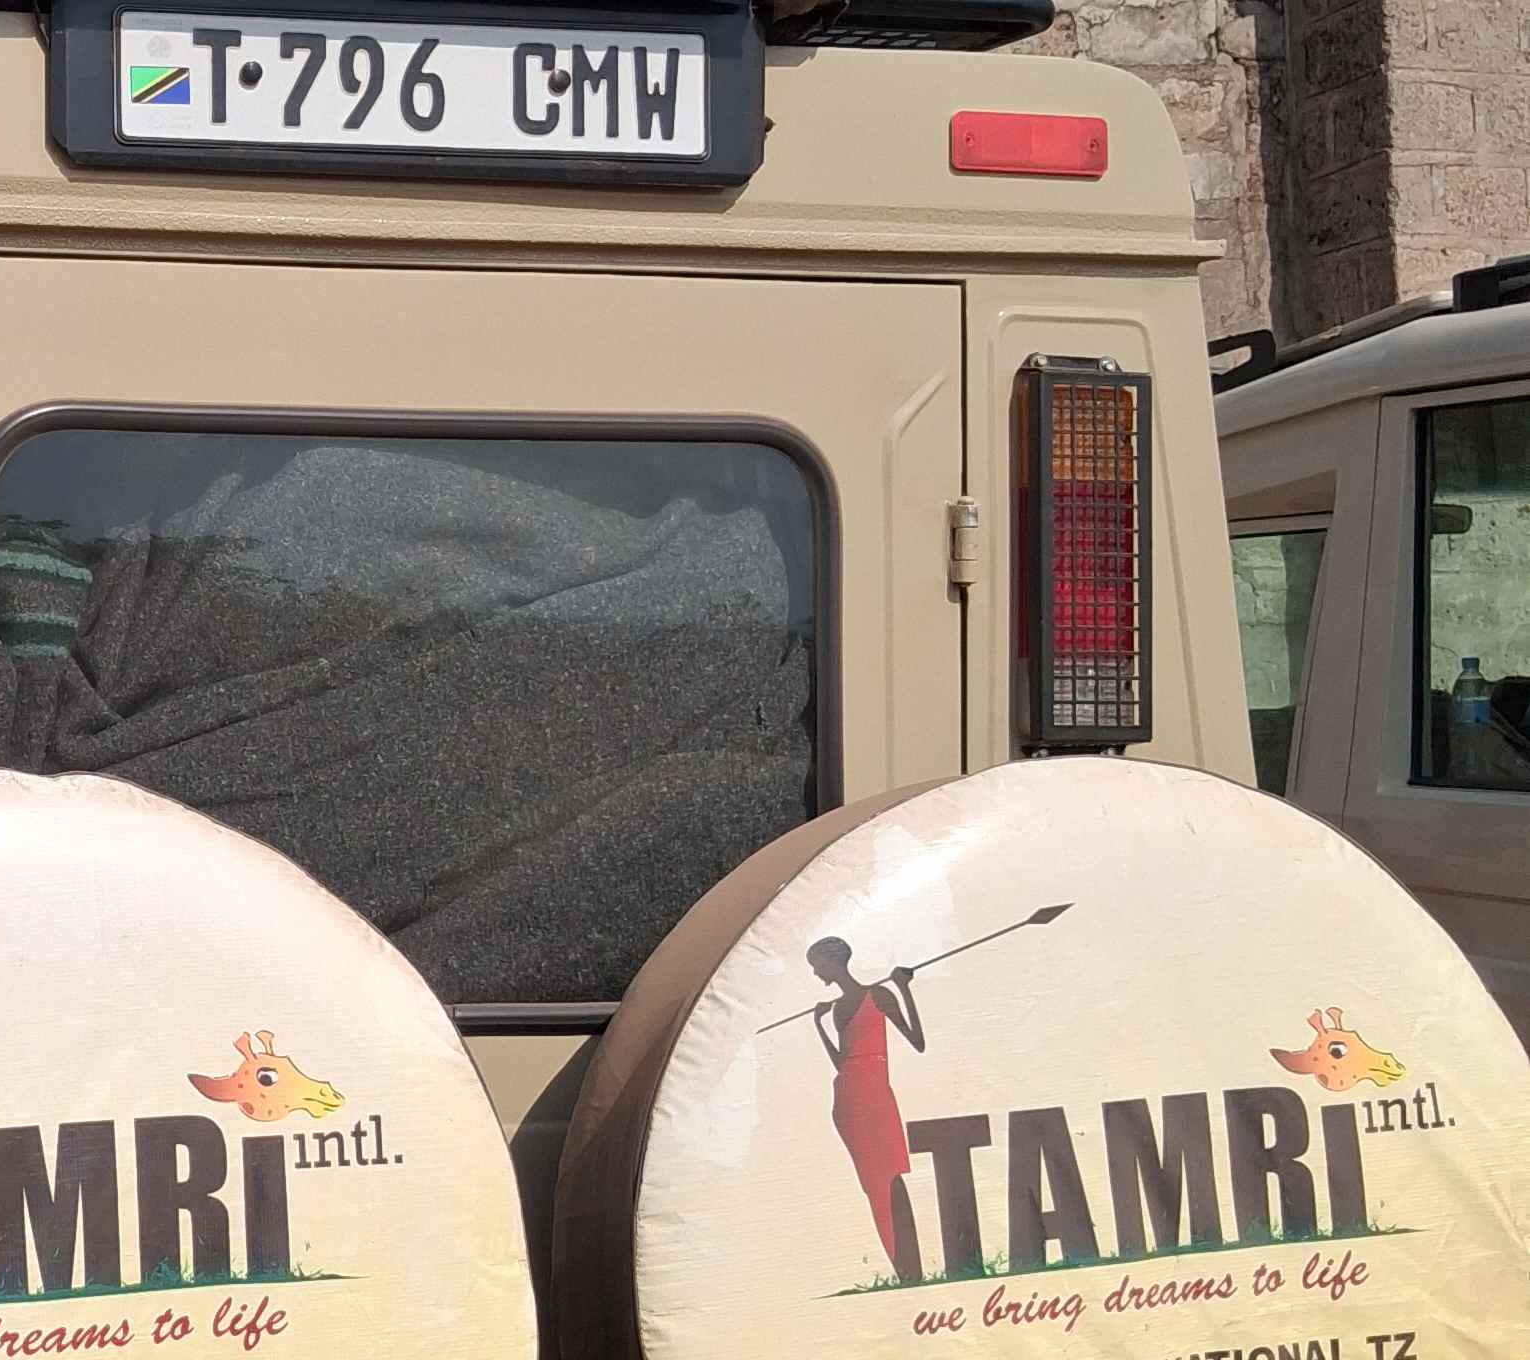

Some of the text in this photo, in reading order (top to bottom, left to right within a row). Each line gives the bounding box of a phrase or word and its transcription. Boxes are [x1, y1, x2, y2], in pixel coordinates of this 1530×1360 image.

[192, 28, 681, 141] T 796 CMW
[1361, 1082, 1456, 1133] intl.
[293, 1114, 404, 1169] intl.
[913, 1249, 1370, 1336] we bring dreams to life
[150, 1308, 193, 1346] to
[212, 1296, 289, 1357] life
